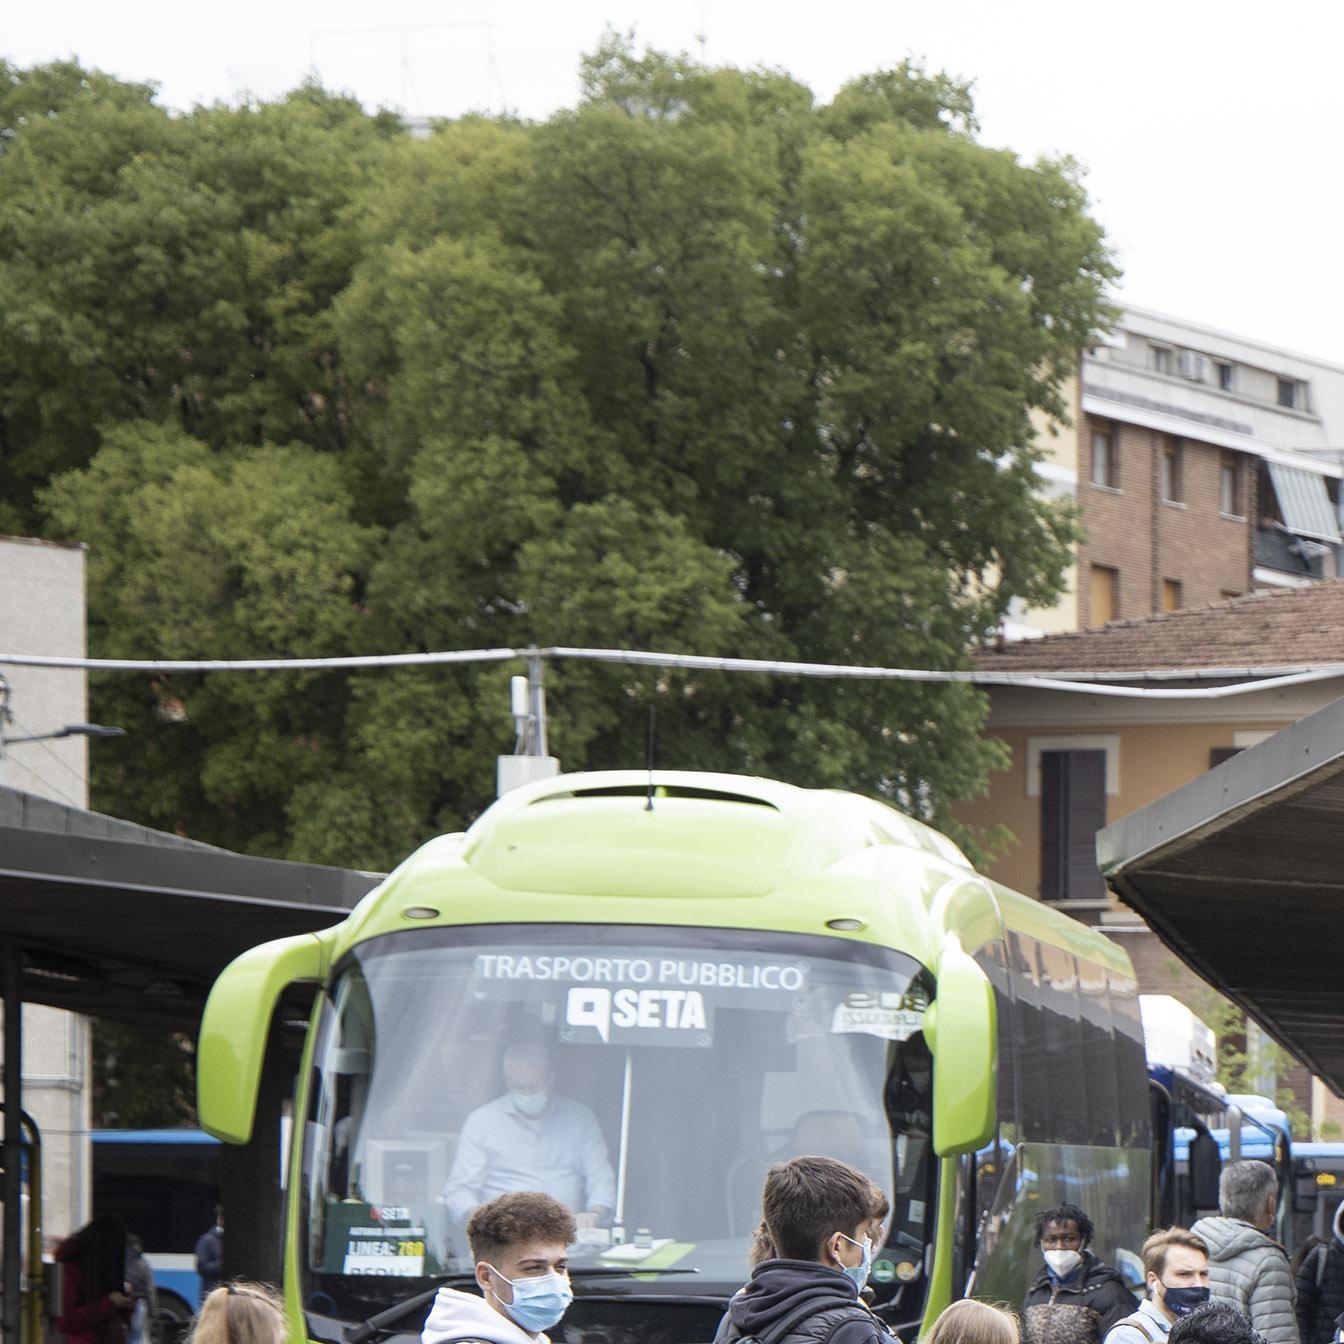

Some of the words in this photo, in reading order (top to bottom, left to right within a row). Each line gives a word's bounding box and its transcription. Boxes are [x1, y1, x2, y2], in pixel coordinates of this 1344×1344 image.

[477, 954, 655, 983] TRASPORTO
[658, 960, 805, 991] PUBBLICO
[611, 988, 708, 1030] SETA
[348, 1240, 397, 1256] LINEA:
